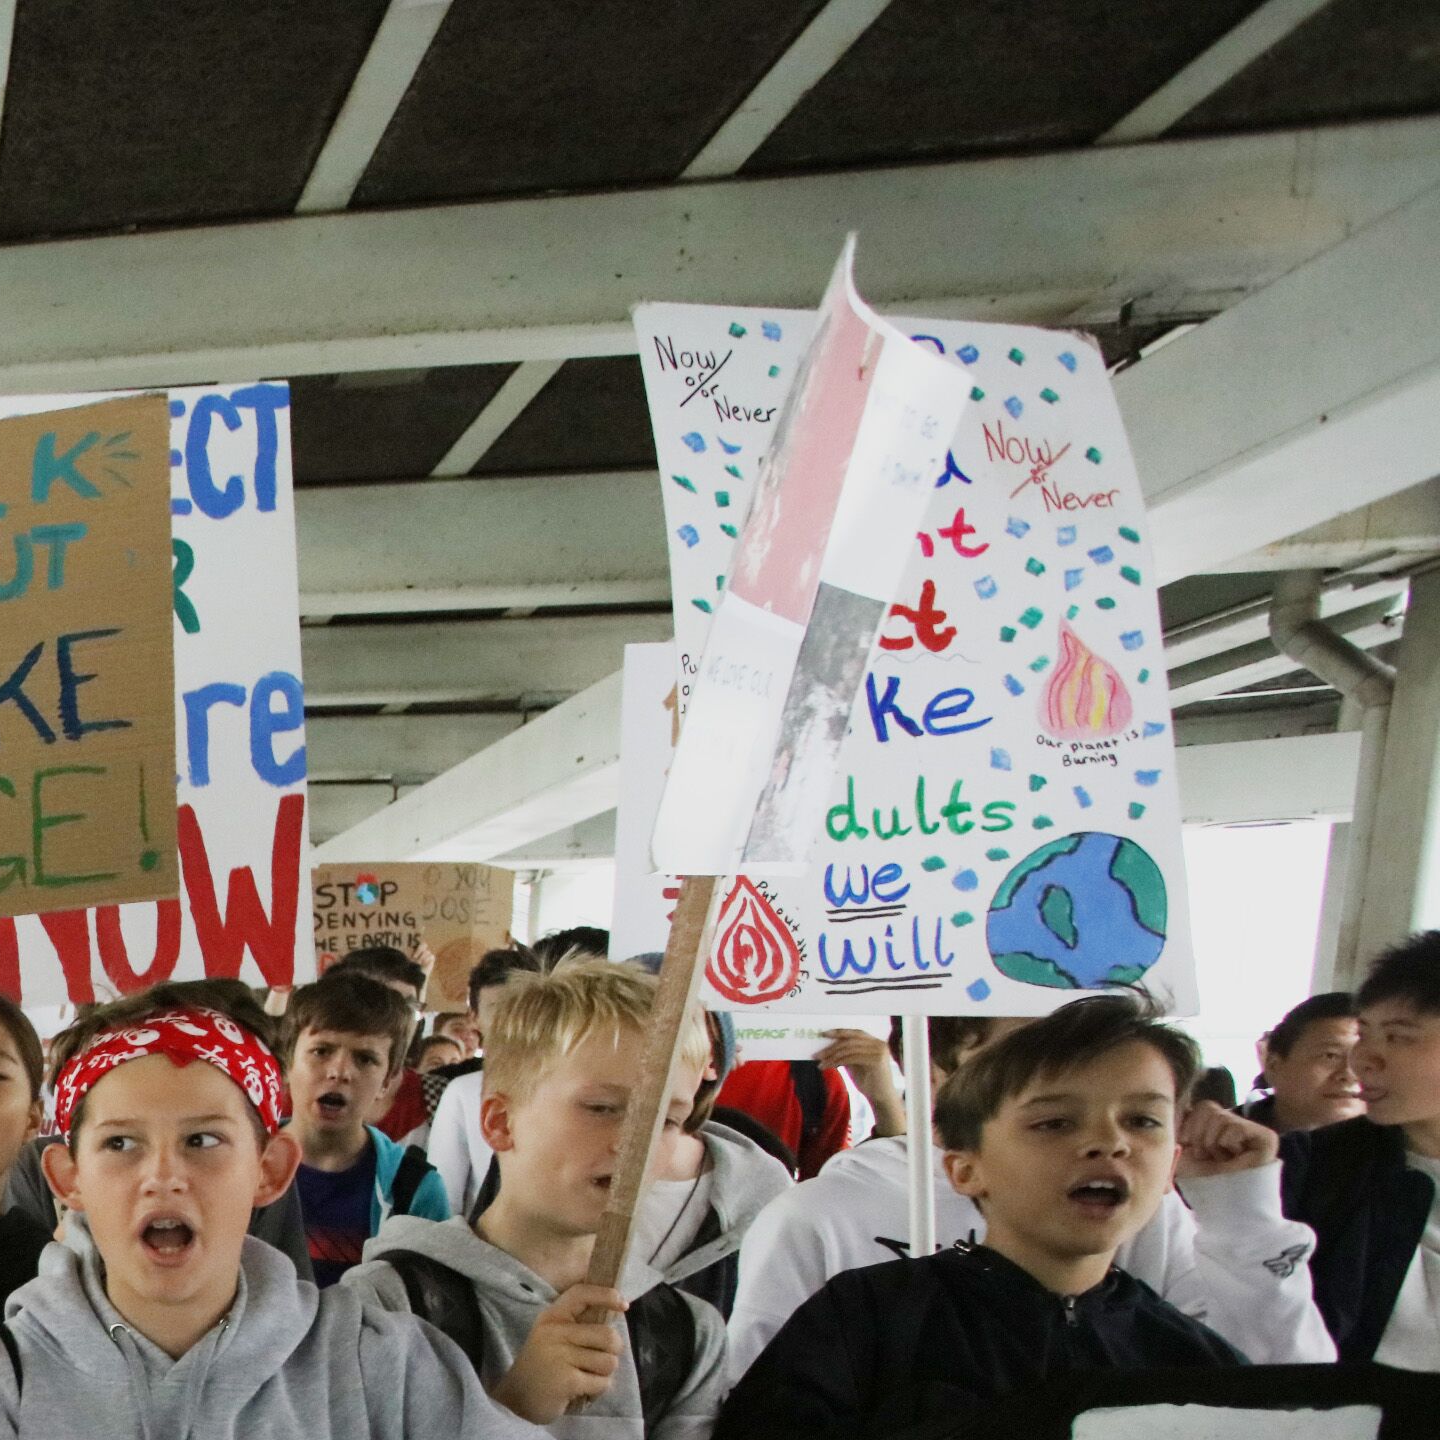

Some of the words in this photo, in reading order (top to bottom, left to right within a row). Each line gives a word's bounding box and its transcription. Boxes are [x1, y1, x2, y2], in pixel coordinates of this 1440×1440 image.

[653, 335, 717, 371] Now
[713, 396, 777, 423] Never
[982, 419, 1053, 466] Now
[1041, 480, 1120, 513] Never
[1062, 752, 1119, 767] Burning
[1070, 739, 1119, 752] planet
